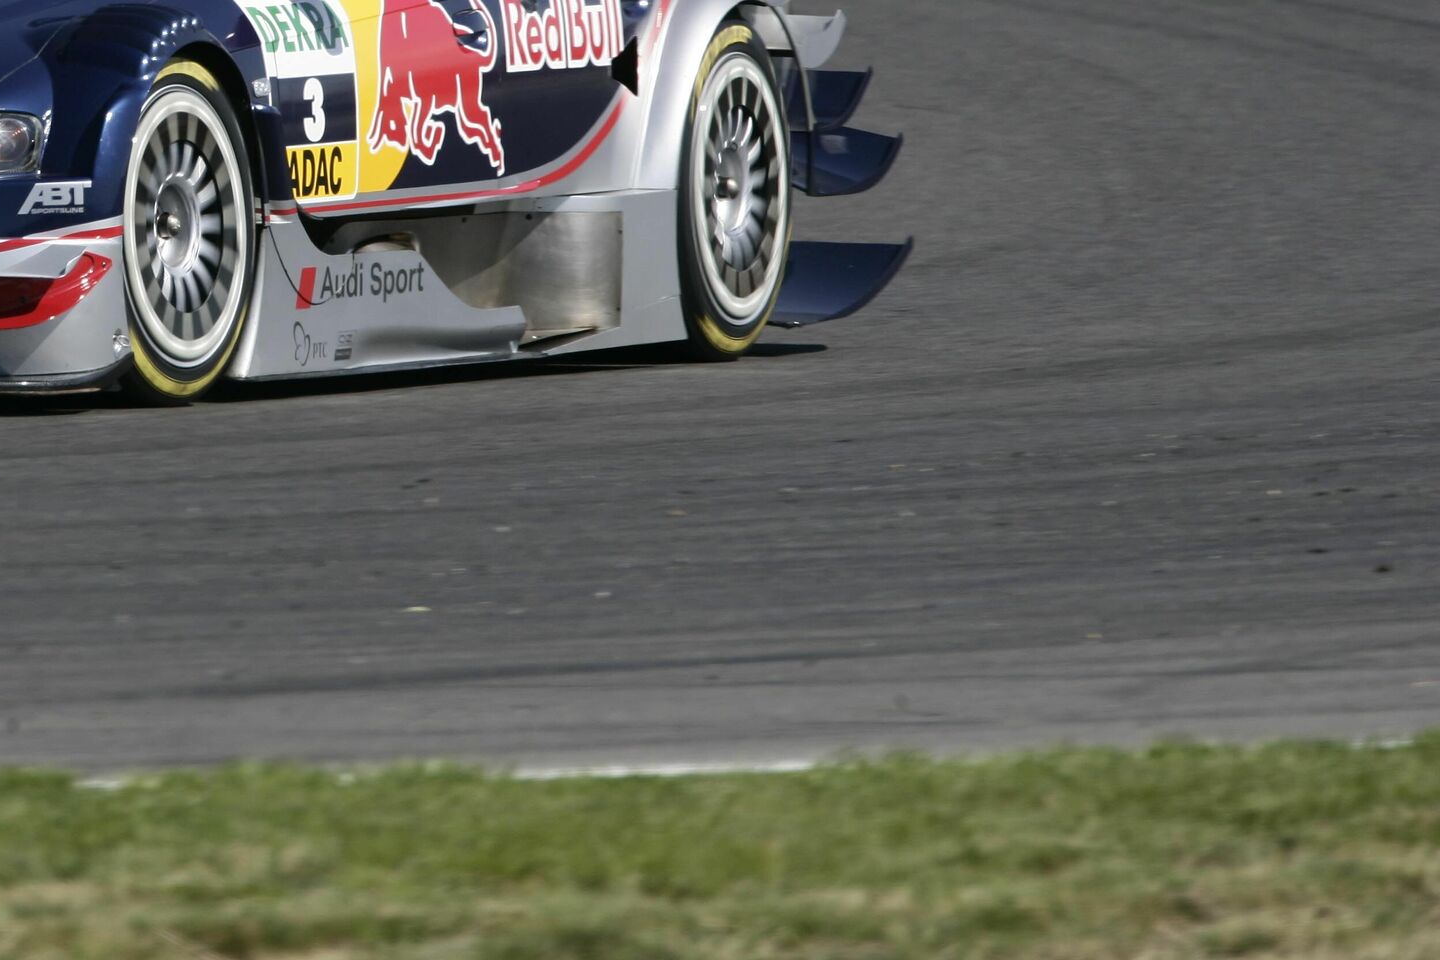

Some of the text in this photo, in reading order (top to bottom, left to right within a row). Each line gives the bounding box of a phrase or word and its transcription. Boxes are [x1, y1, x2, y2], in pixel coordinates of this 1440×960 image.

[244, 0, 349, 53] DEKRA
[303, 77, 326, 143] 3
[289, 146, 342, 197] ADAC
[17, 180, 92, 215] ABT
[320, 262, 424, 303] Audi Sport
